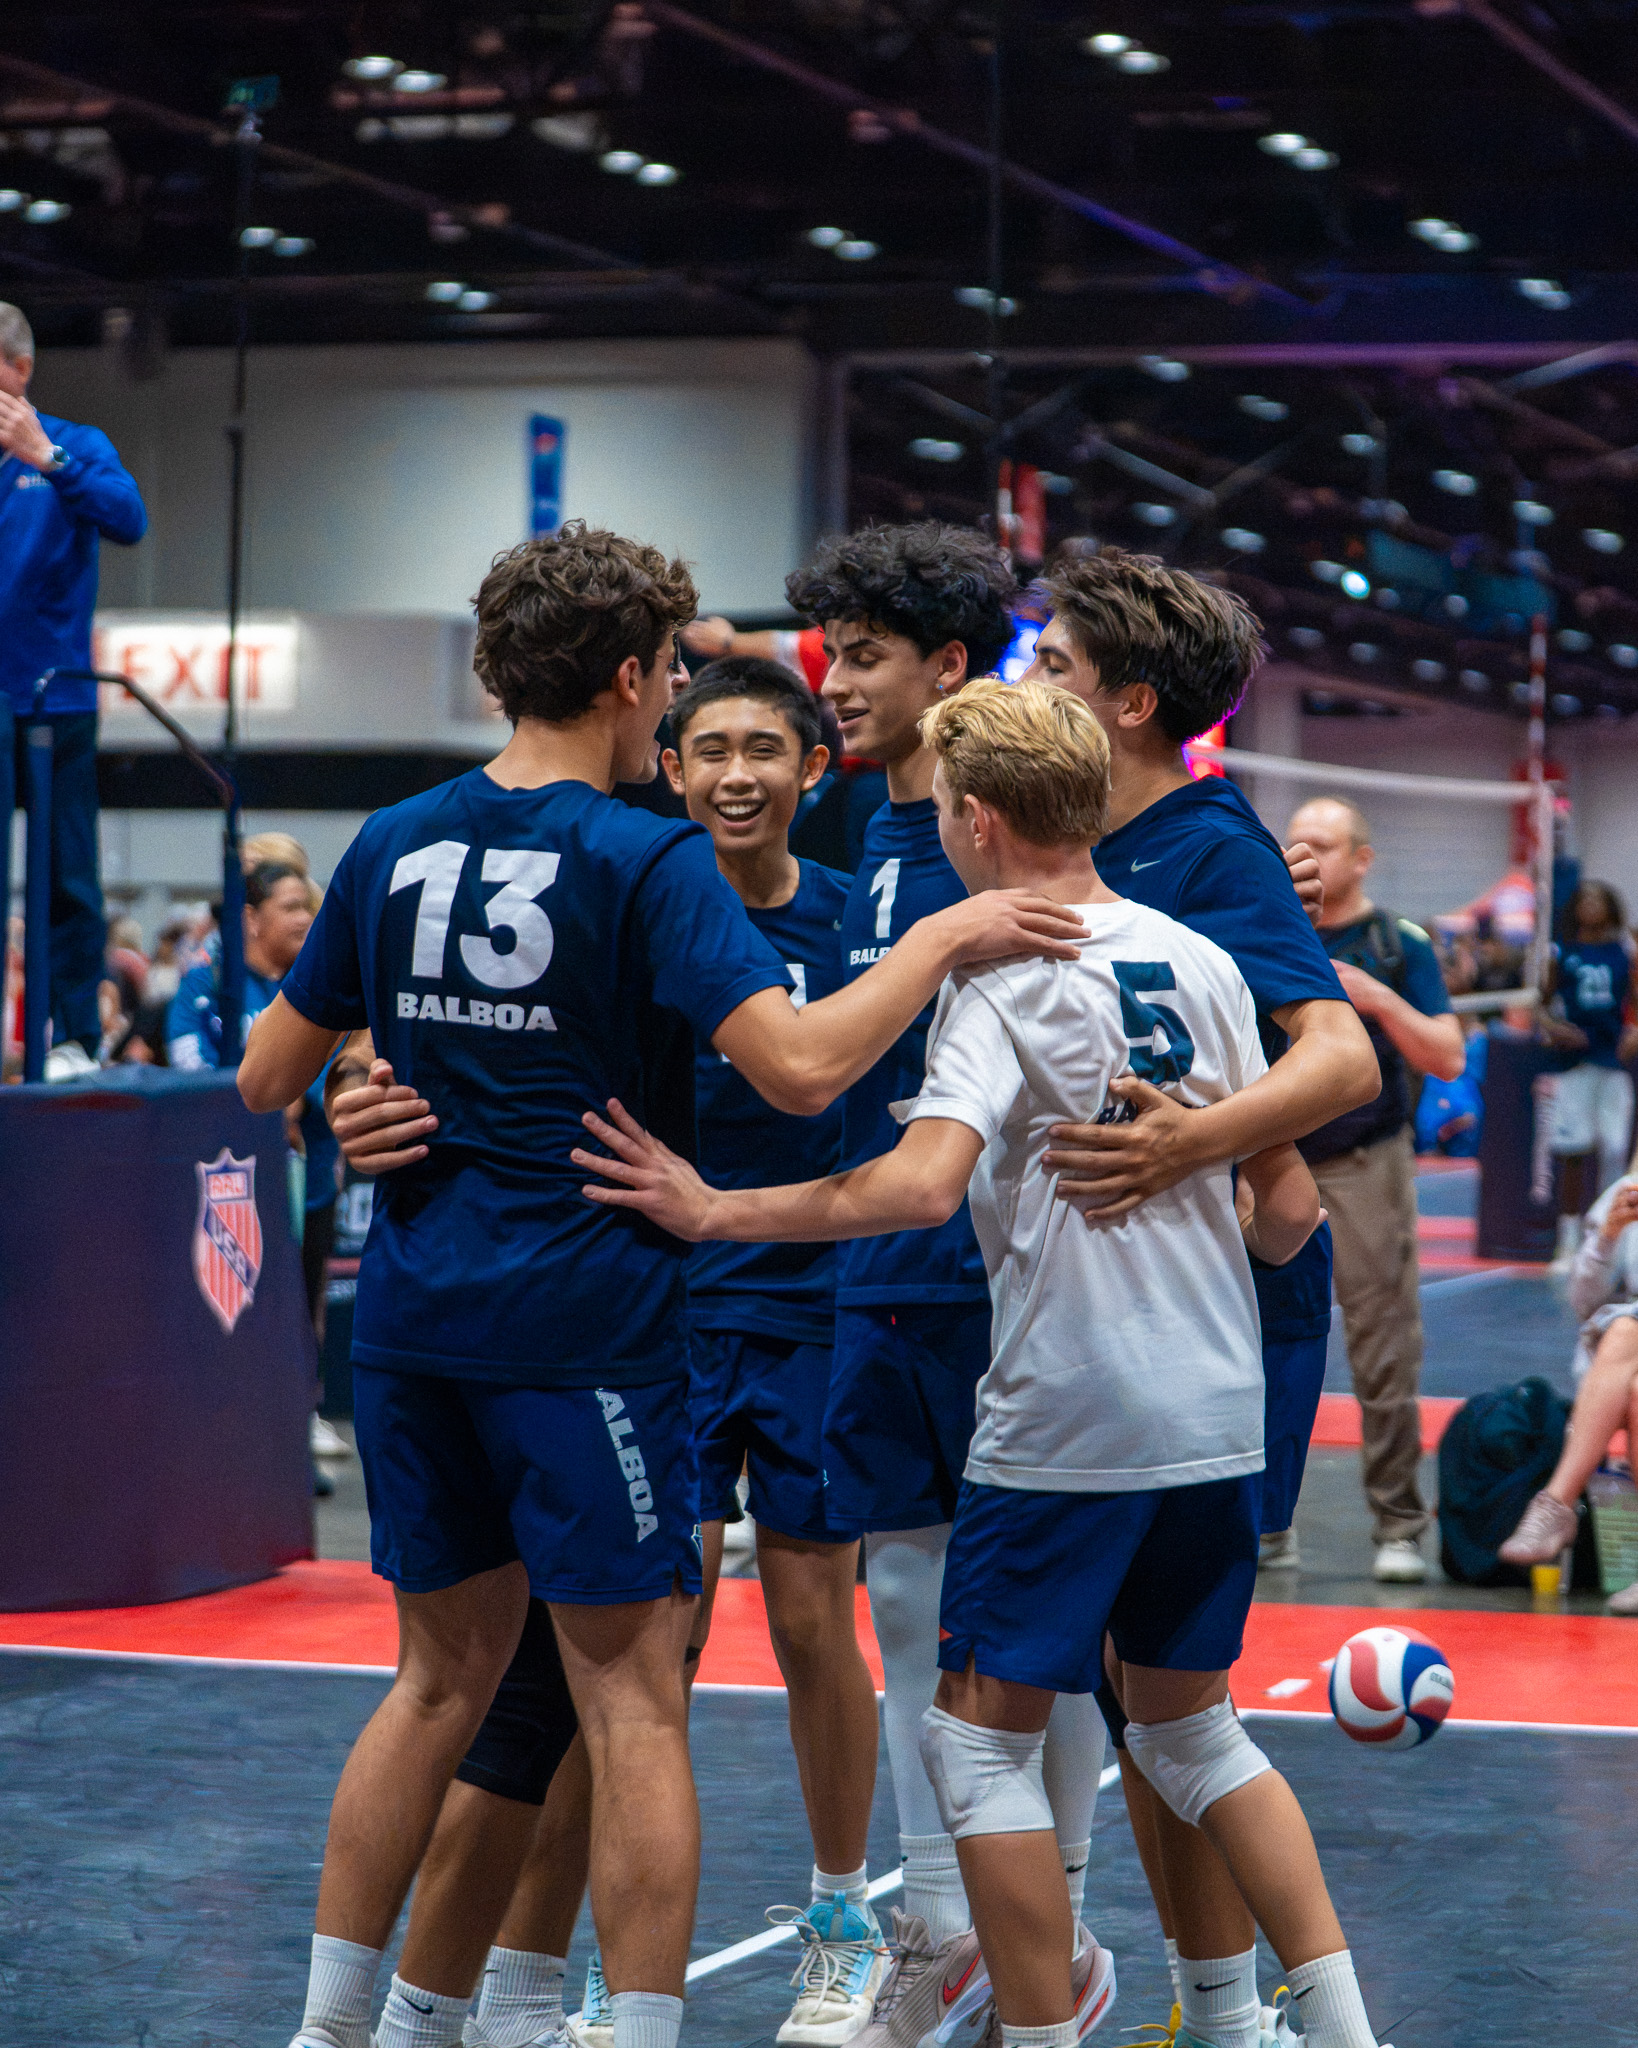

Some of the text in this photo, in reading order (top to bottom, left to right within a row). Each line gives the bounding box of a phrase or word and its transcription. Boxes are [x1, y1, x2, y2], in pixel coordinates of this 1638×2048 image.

[122, 643, 278, 702] EXIT
[389, 840, 561, 989] 13
[869, 858, 901, 939] 1
[397, 992, 557, 1030] BALBOA
[1110, 961, 1195, 1085] 5
[595, 1387, 658, 1543] ALBOA
